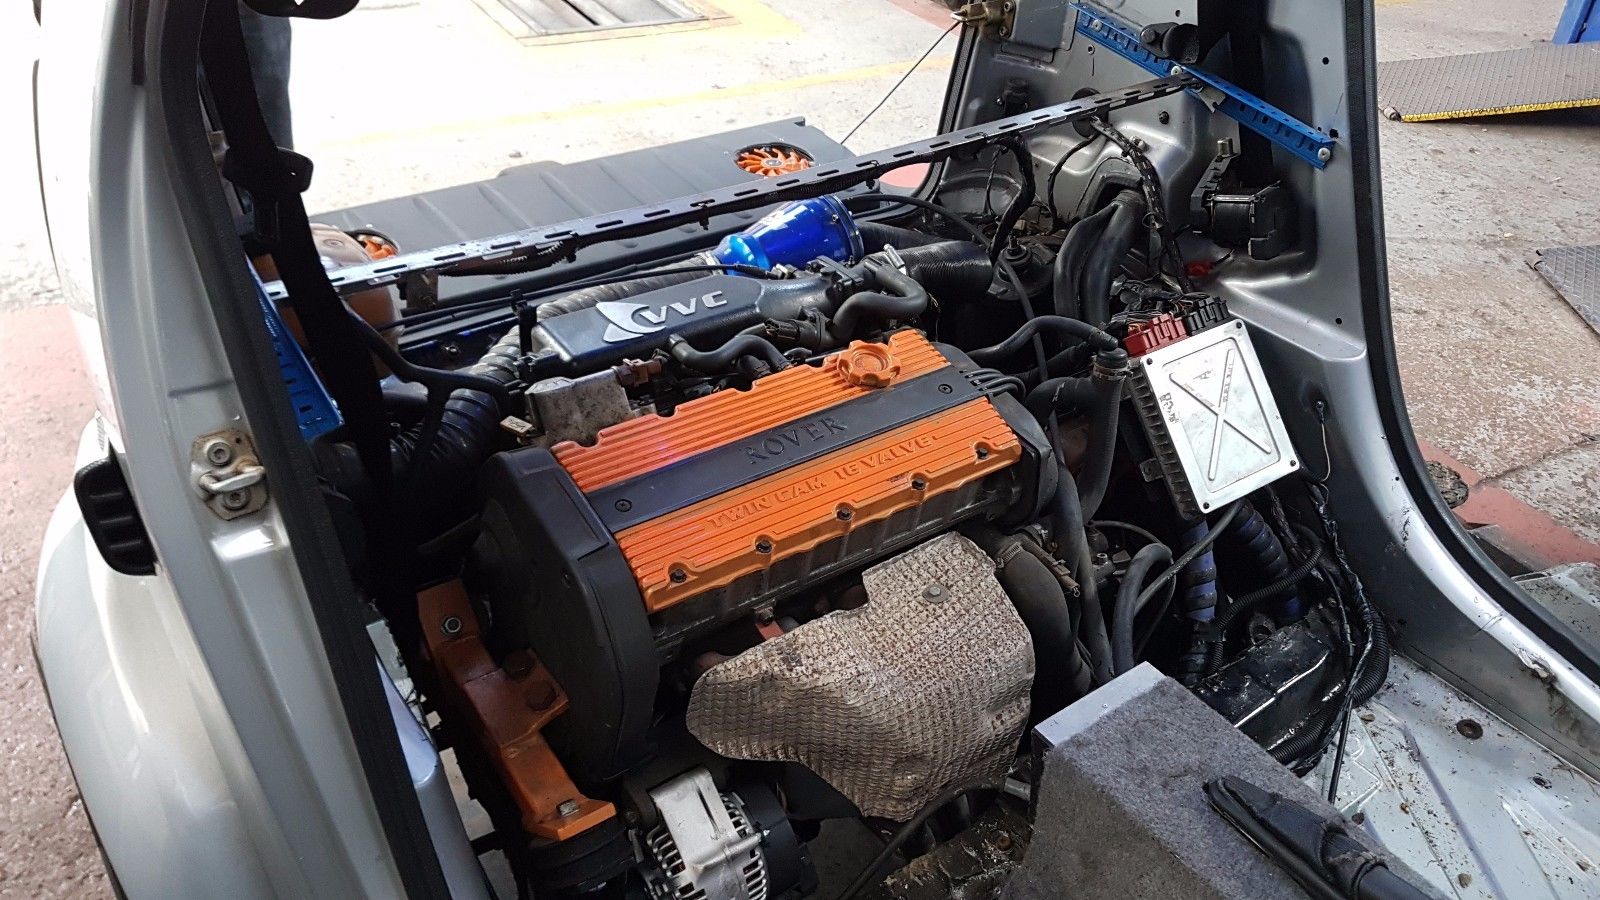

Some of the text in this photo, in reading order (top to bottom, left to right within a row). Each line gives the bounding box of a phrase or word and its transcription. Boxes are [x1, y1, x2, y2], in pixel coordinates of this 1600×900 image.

[639, 290, 728, 324] VVC
[741, 415, 849, 464] ROVER
[707, 436, 933, 529] TWIN CAM 16 VALVE
